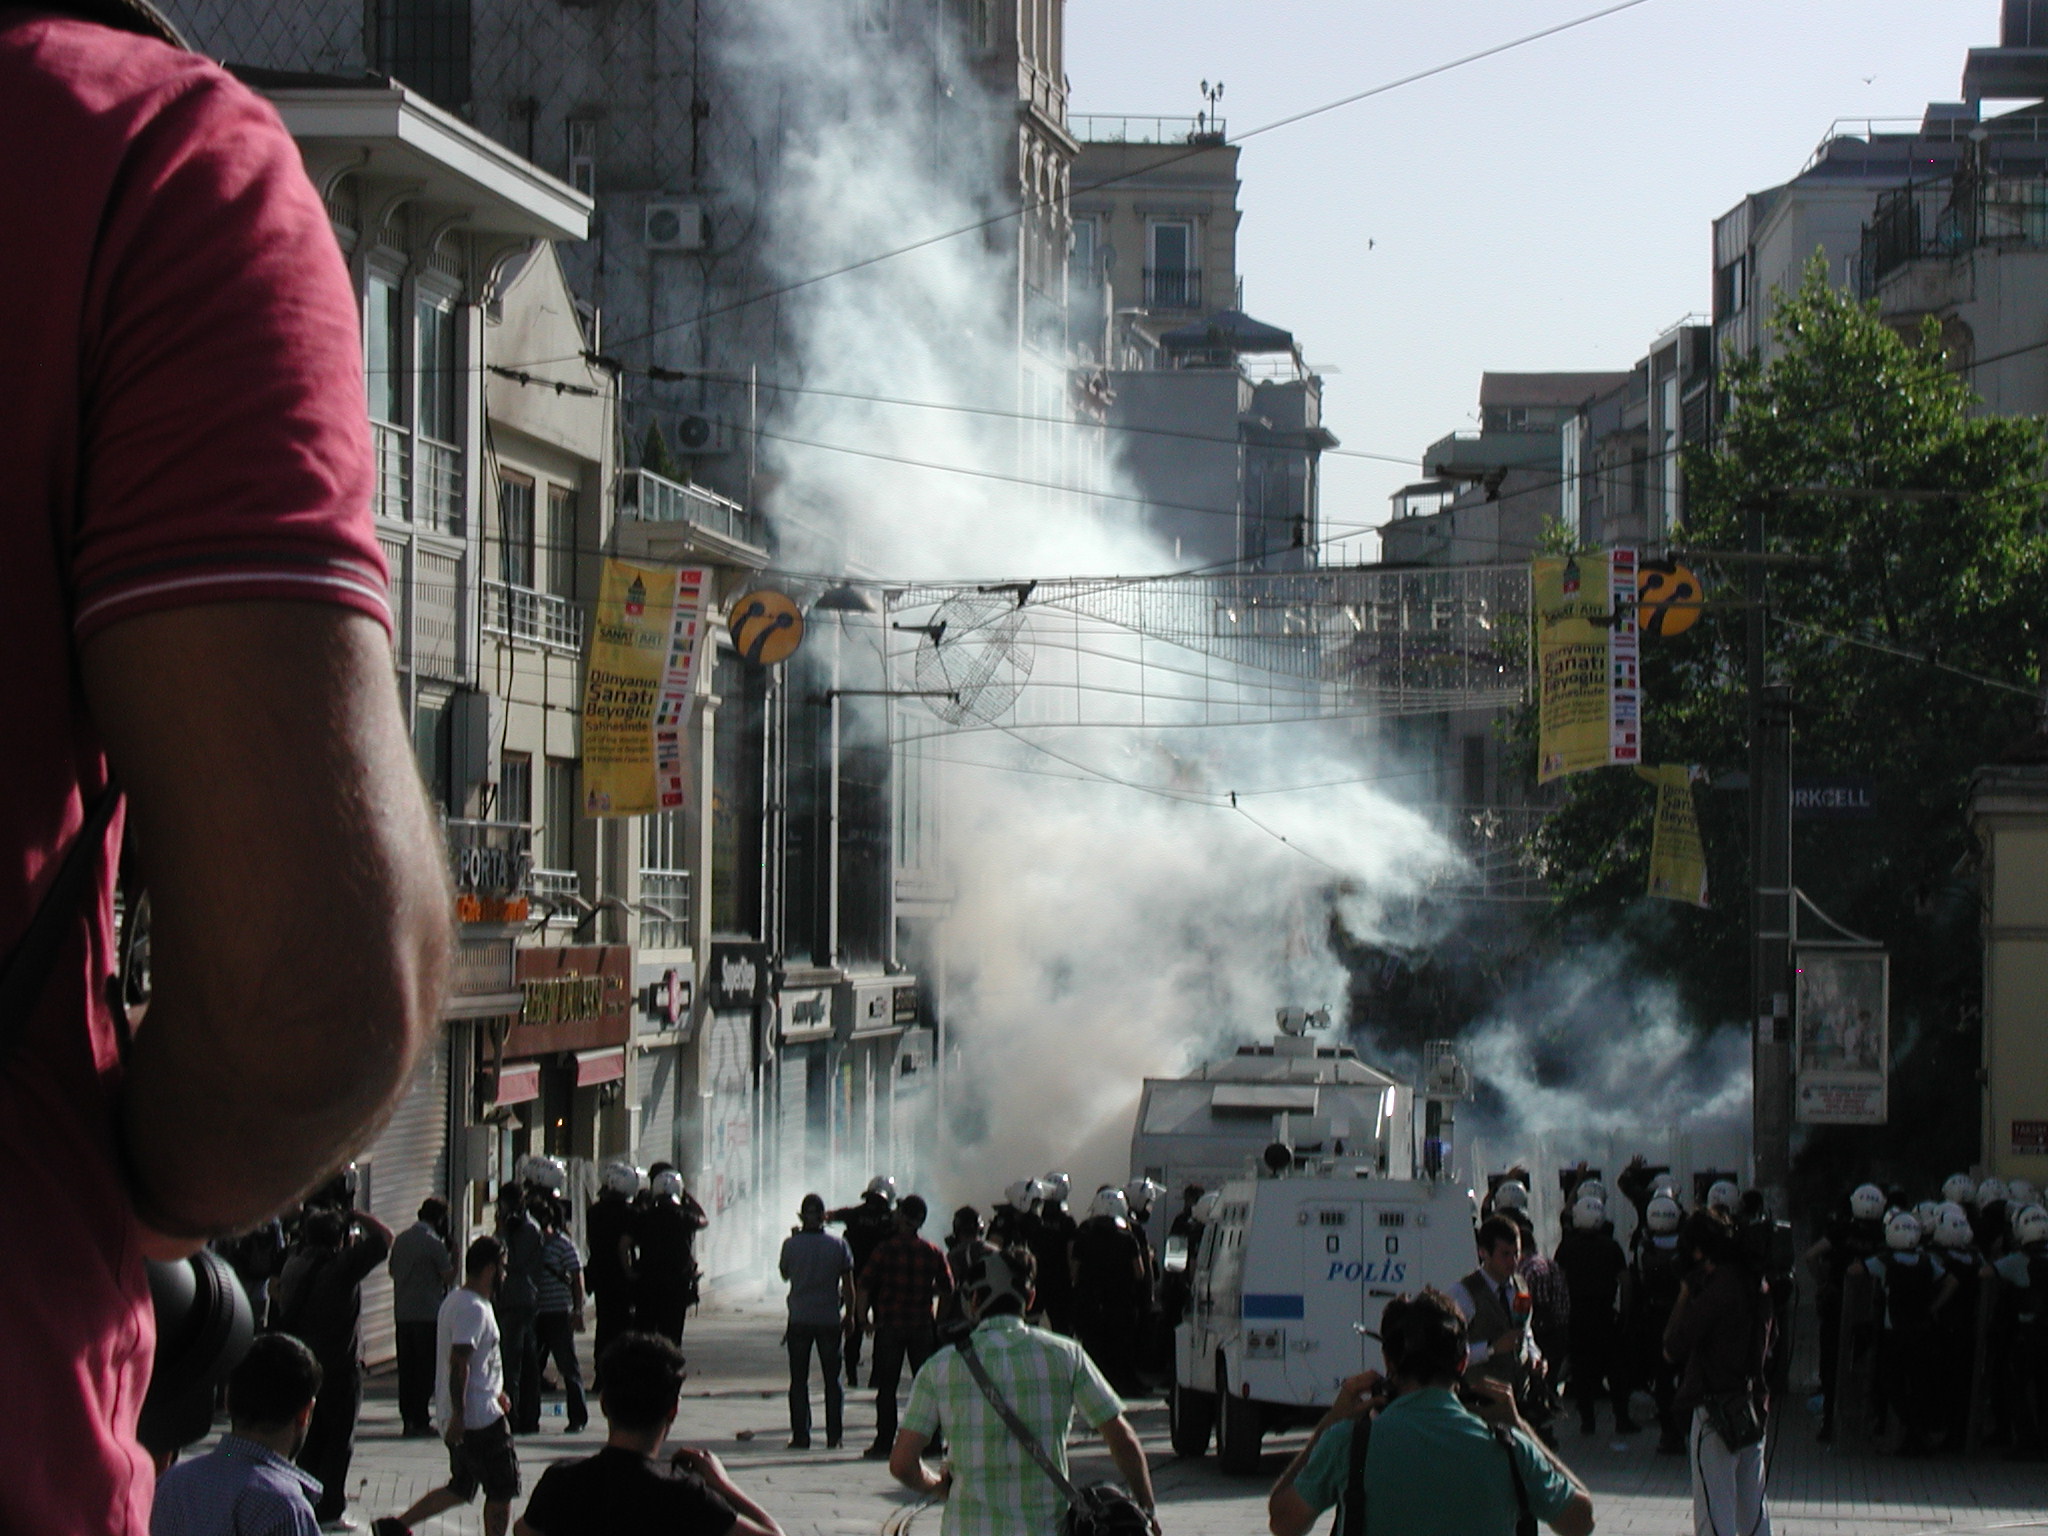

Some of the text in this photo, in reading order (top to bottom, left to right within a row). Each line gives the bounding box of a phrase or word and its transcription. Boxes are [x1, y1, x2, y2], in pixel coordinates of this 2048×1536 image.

[590, 670, 657, 689] Dünyanın
[589, 683, 653, 704] Sanatı
[586, 702, 650, 720] Beyoğlu
[459, 847, 508, 888] PORTA
[1328, 1257, 1406, 1283] POLİS
